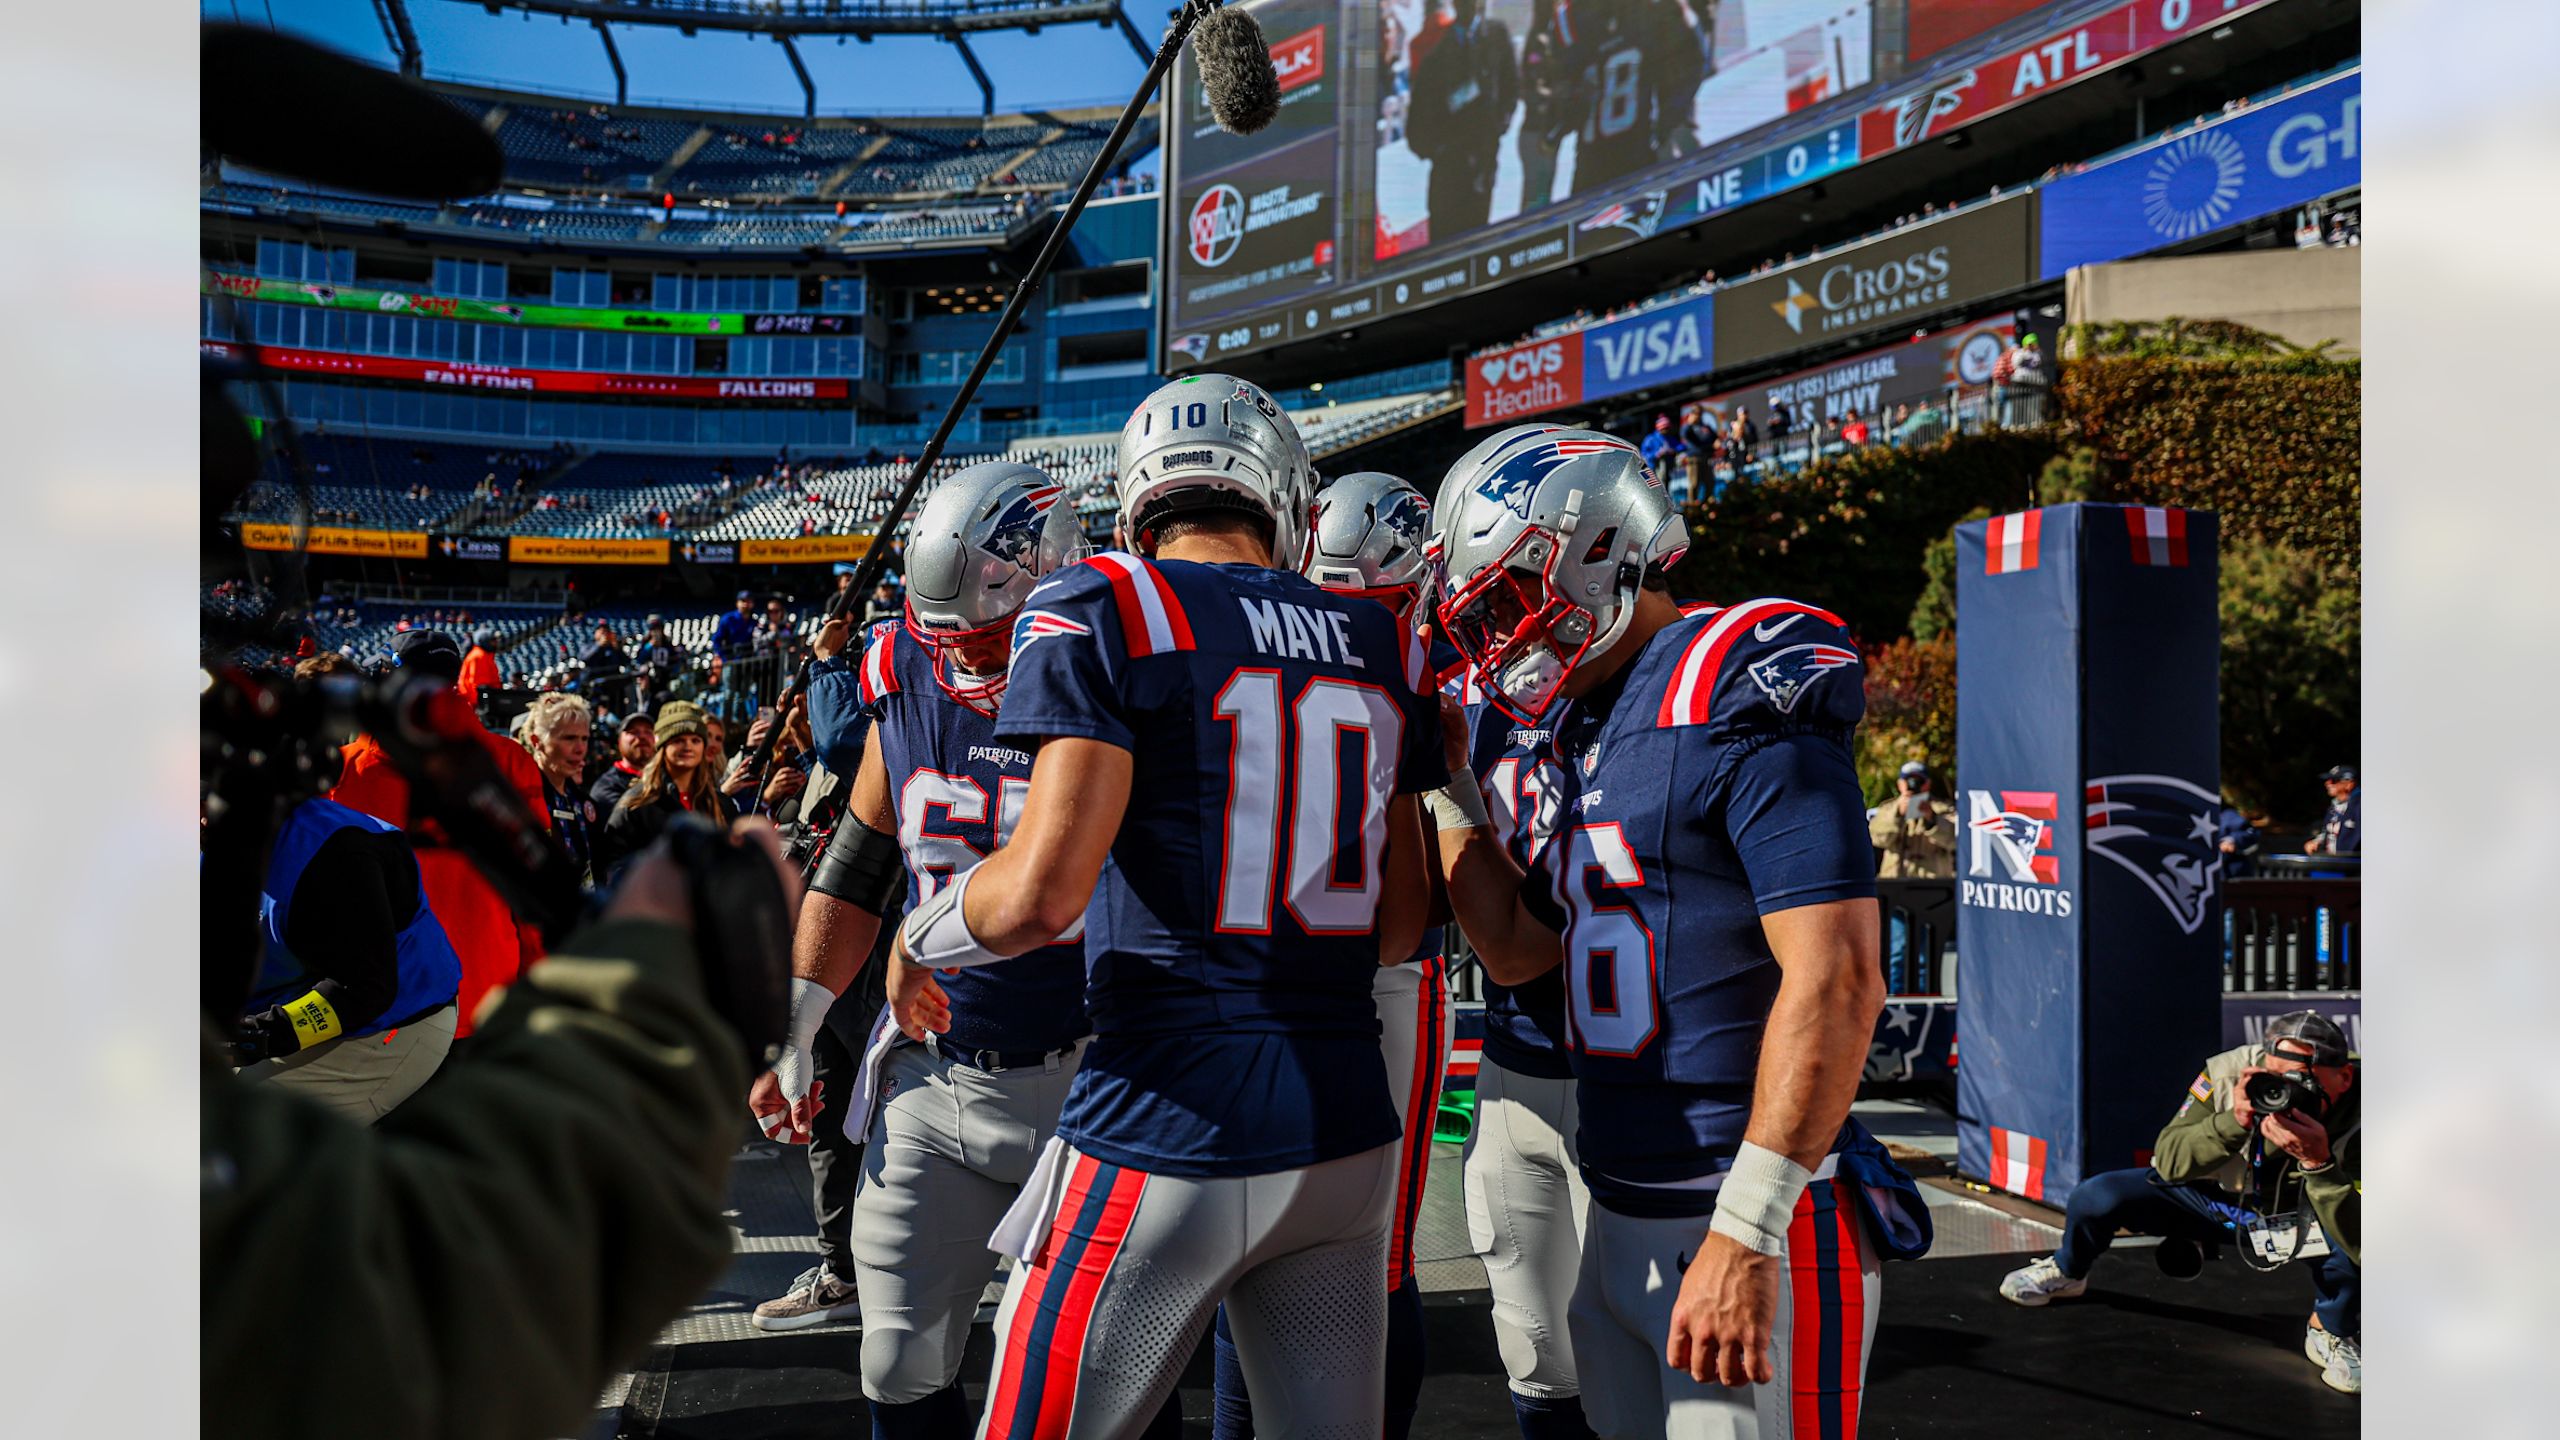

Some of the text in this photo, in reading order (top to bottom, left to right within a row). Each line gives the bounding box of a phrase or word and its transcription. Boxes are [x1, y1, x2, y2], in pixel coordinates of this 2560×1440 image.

[2011, 0, 2191, 97] ATL 0
[1697, 144, 1808, 213] NE 0
[1488, 255, 1500, 276] 0
[1396, 283, 1409, 304] 0
[1822, 281, 1950, 332] INSURANCE
[755, 314, 770, 332] GO
[1306, 309, 1319, 329] 0
[1507, 342, 1563, 382] CVS
[1594, 314, 1702, 381] VISA
[719, 381, 816, 397] FALCONS
[1826, 365, 1861, 393] LIAM
[1861, 355, 1897, 381] EARL
[1171, 402, 1206, 431] 10
[1482, 375, 1563, 420] Health
[1825, 382, 1881, 420] NAVY
[1162, 450, 1214, 471] PATRIOTS
[1238, 597, 1366, 669] MAYE
[967, 745, 1030, 766] PATRIOTS
[1505, 729, 1553, 747] PATRIOTS
[1212, 666, 1406, 936] 10
[1967, 790, 2060, 885] NE
[1962, 879, 2073, 918] PATRIOTS
[305, 1001, 326, 1026] WEEK
[318, 1024, 329, 1032] 9
